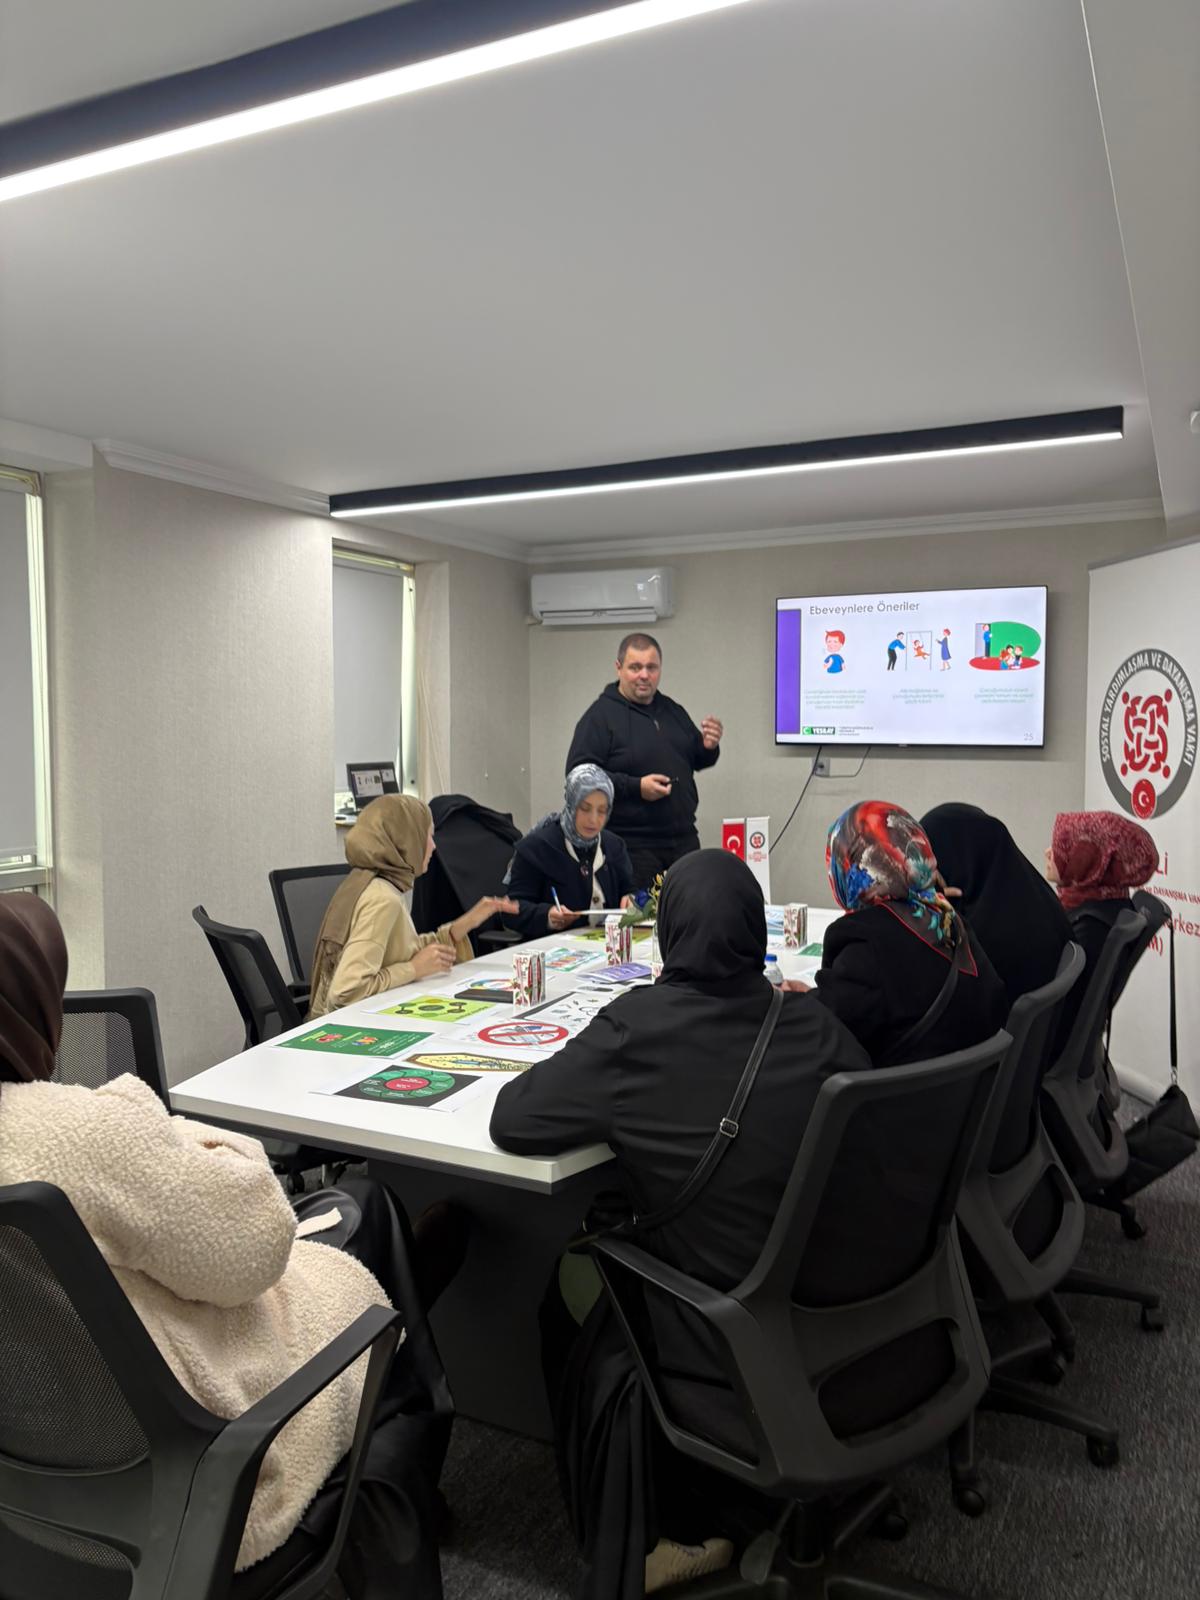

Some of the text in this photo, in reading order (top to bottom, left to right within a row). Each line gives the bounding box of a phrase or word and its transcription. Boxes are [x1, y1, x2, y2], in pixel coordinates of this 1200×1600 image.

[809, 600, 920, 615] Ebeveynlere Öneriler
[1101, 715, 1111, 762] SOSYAL
[1151, 651, 1162, 668] VE
[1184, 724, 1197, 767] VAKFI
